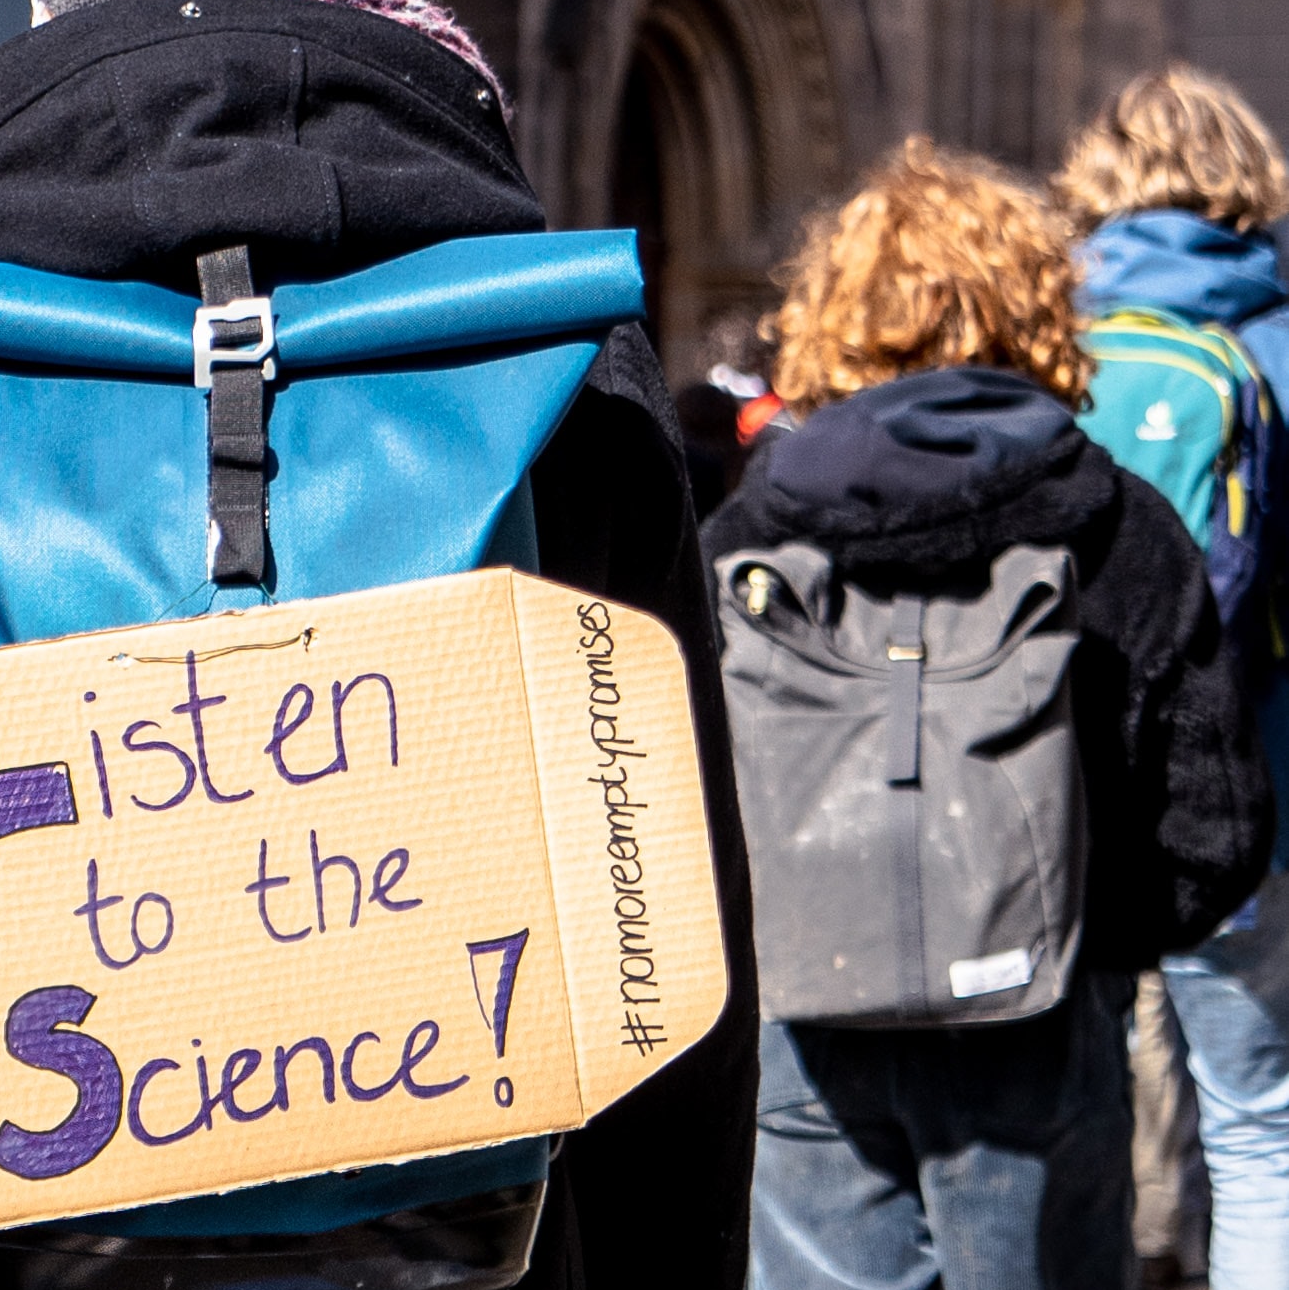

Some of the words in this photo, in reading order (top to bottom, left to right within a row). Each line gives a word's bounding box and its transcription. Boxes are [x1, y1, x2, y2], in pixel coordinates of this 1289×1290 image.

[74, 858, 175, 969] to
[246, 830, 422, 943] the
[575, 601, 668, 1057] #nomoreemptypromises
